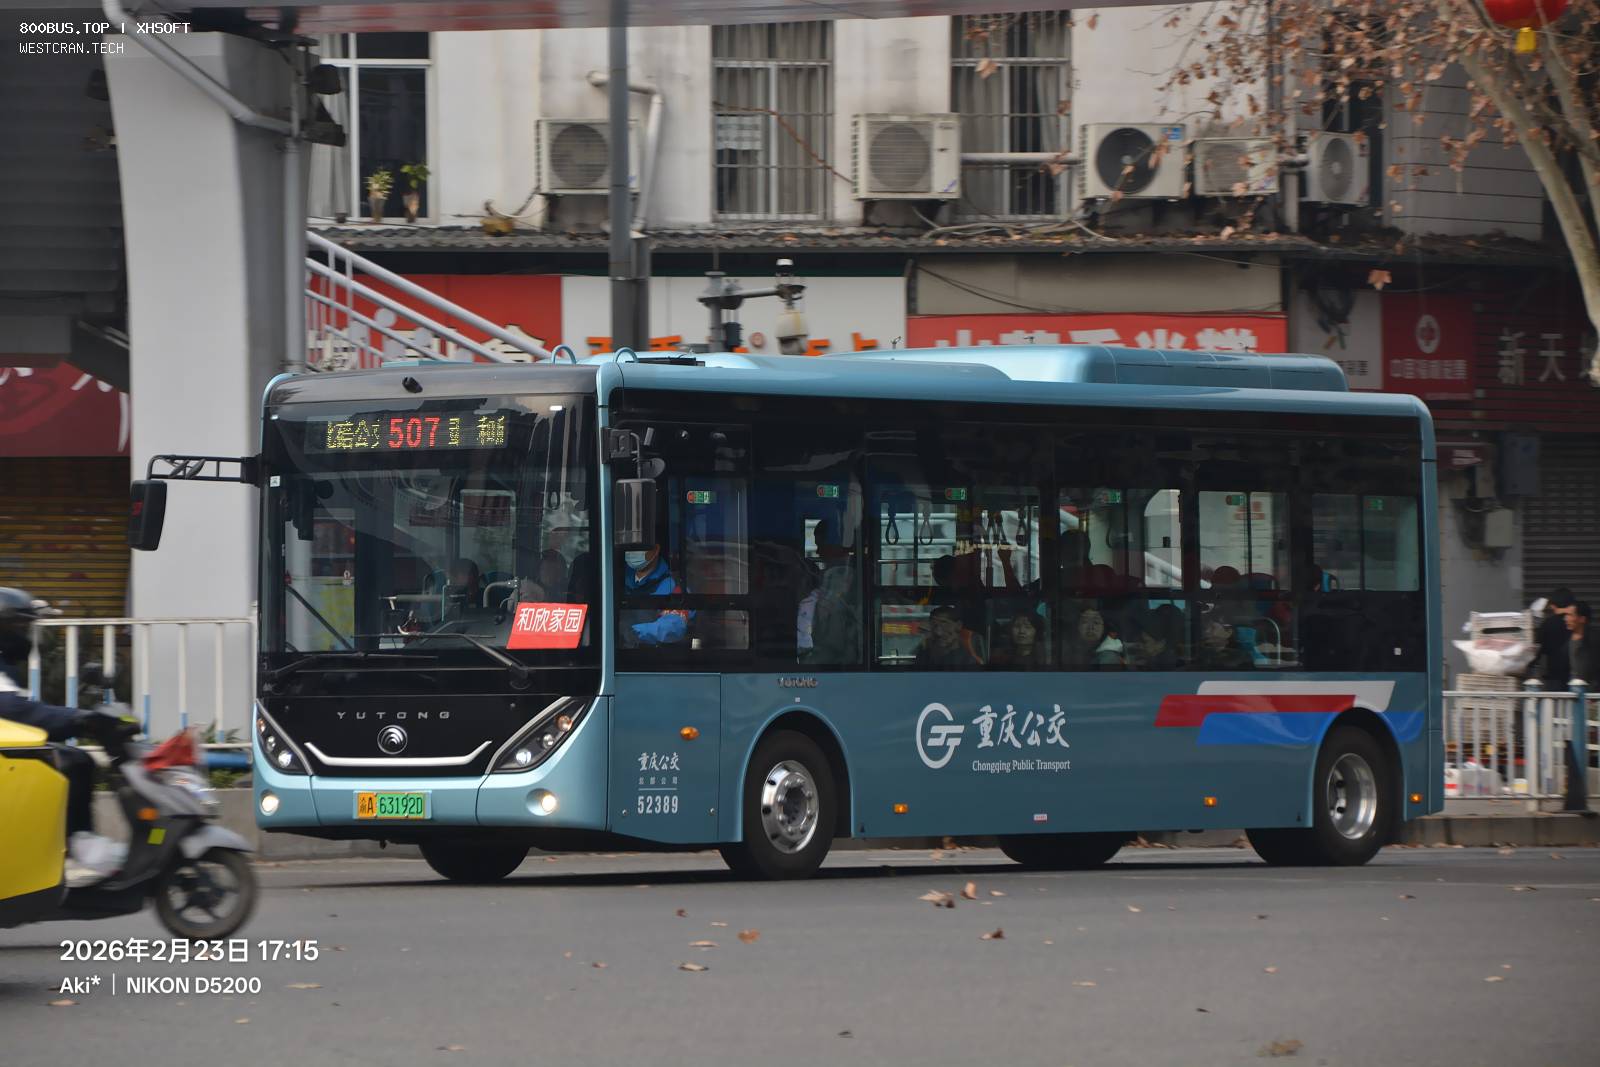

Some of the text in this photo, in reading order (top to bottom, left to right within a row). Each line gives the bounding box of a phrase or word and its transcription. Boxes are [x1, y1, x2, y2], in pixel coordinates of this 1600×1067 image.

[388, 416, 441, 448] 507
[517, 607, 583, 633] 和欣家园
[337, 711, 450, 720] YUTONG
[972, 703, 1070, 749] 重庆公交
[638, 751, 680, 771] 重庆公交
[972, 759, 1070, 774] Chongqing Public Transport
[637, 795, 679, 814] 52389
